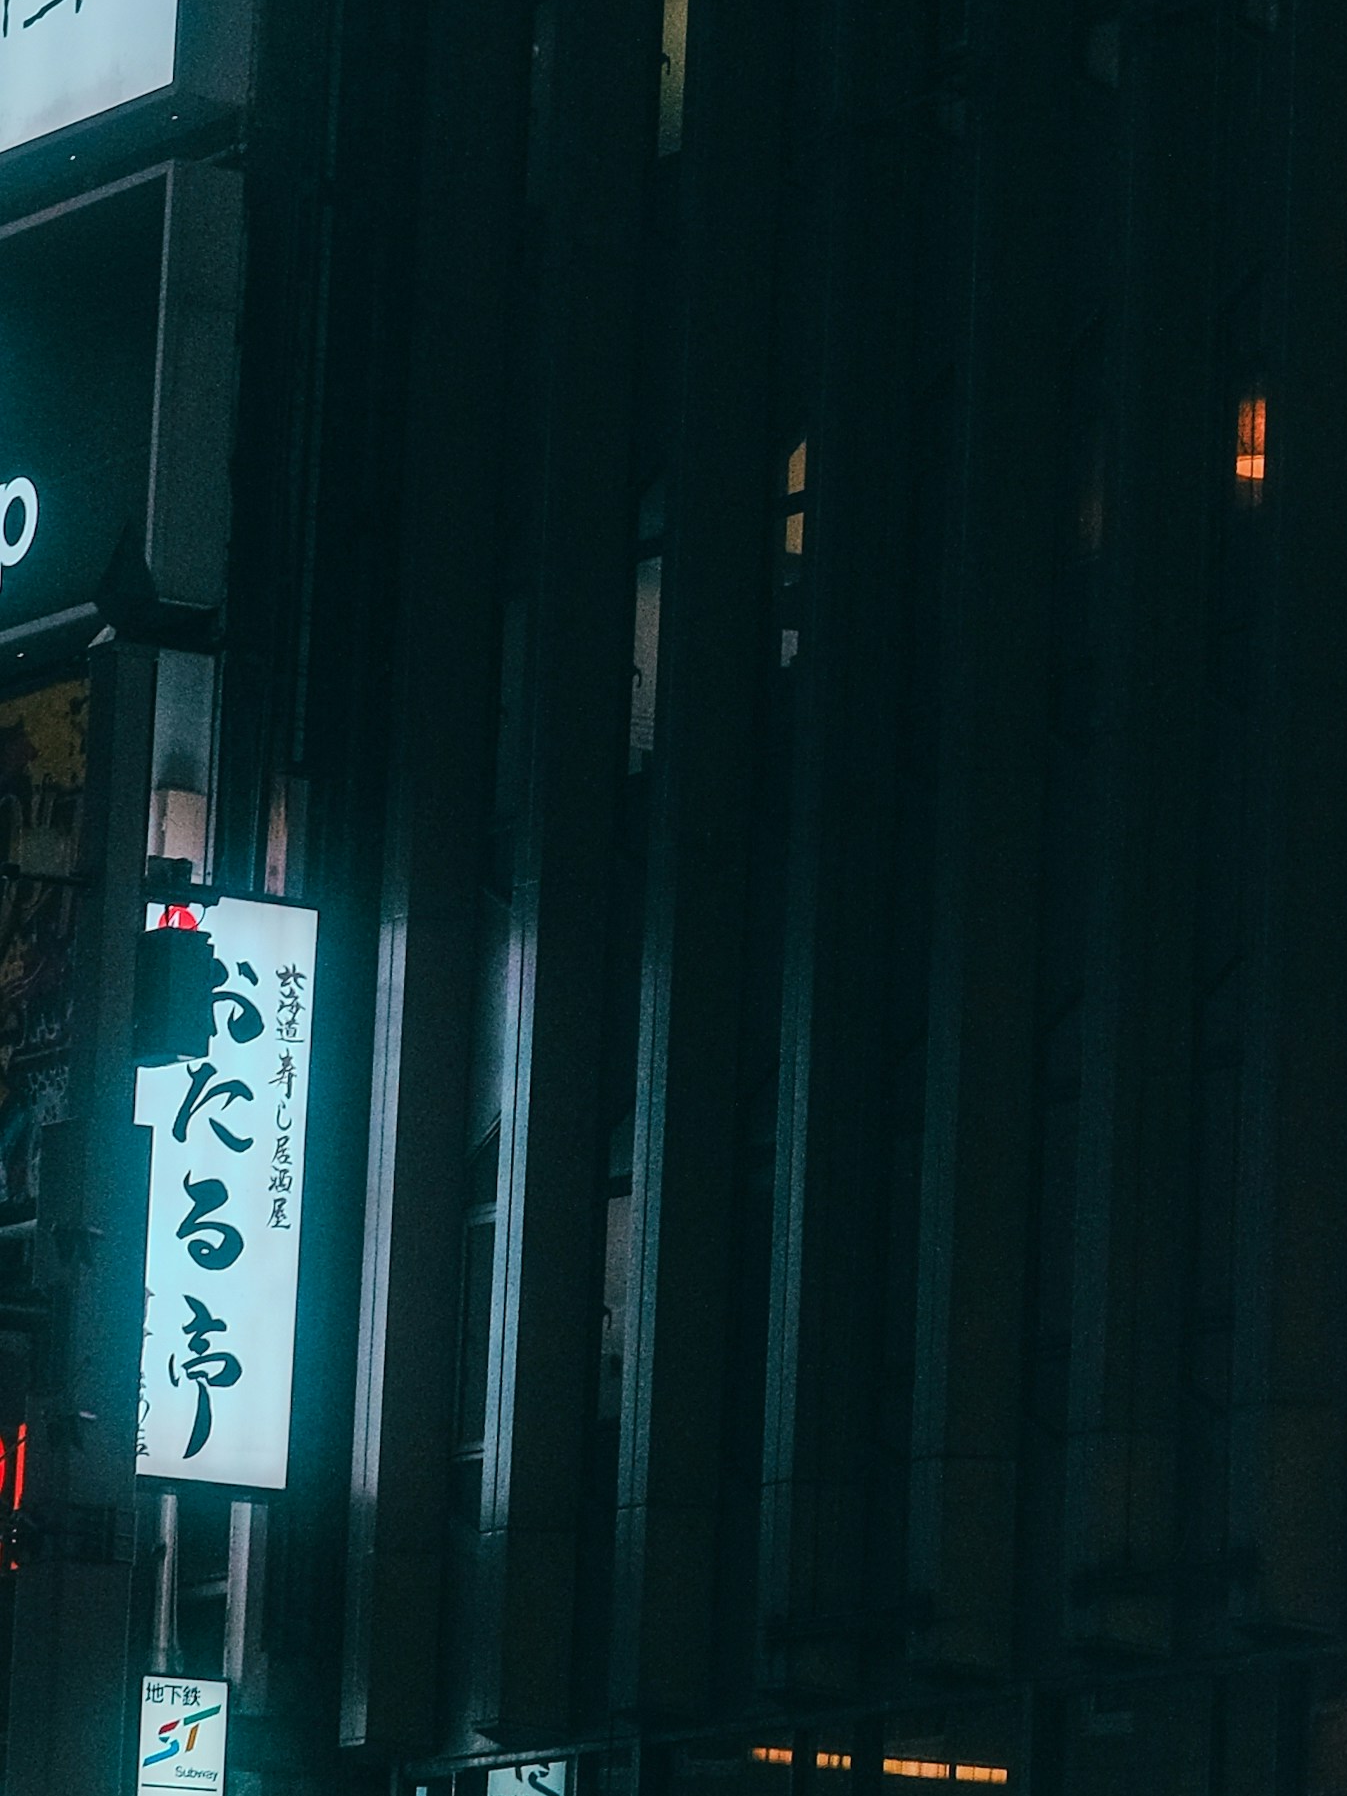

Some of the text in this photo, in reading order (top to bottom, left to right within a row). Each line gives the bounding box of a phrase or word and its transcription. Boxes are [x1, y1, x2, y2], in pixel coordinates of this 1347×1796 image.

[274, 963, 306, 1043] 北海道
[144, 1681, 201, 1707] 地下鉄
[174, 1765, 219, 1781] Subway
